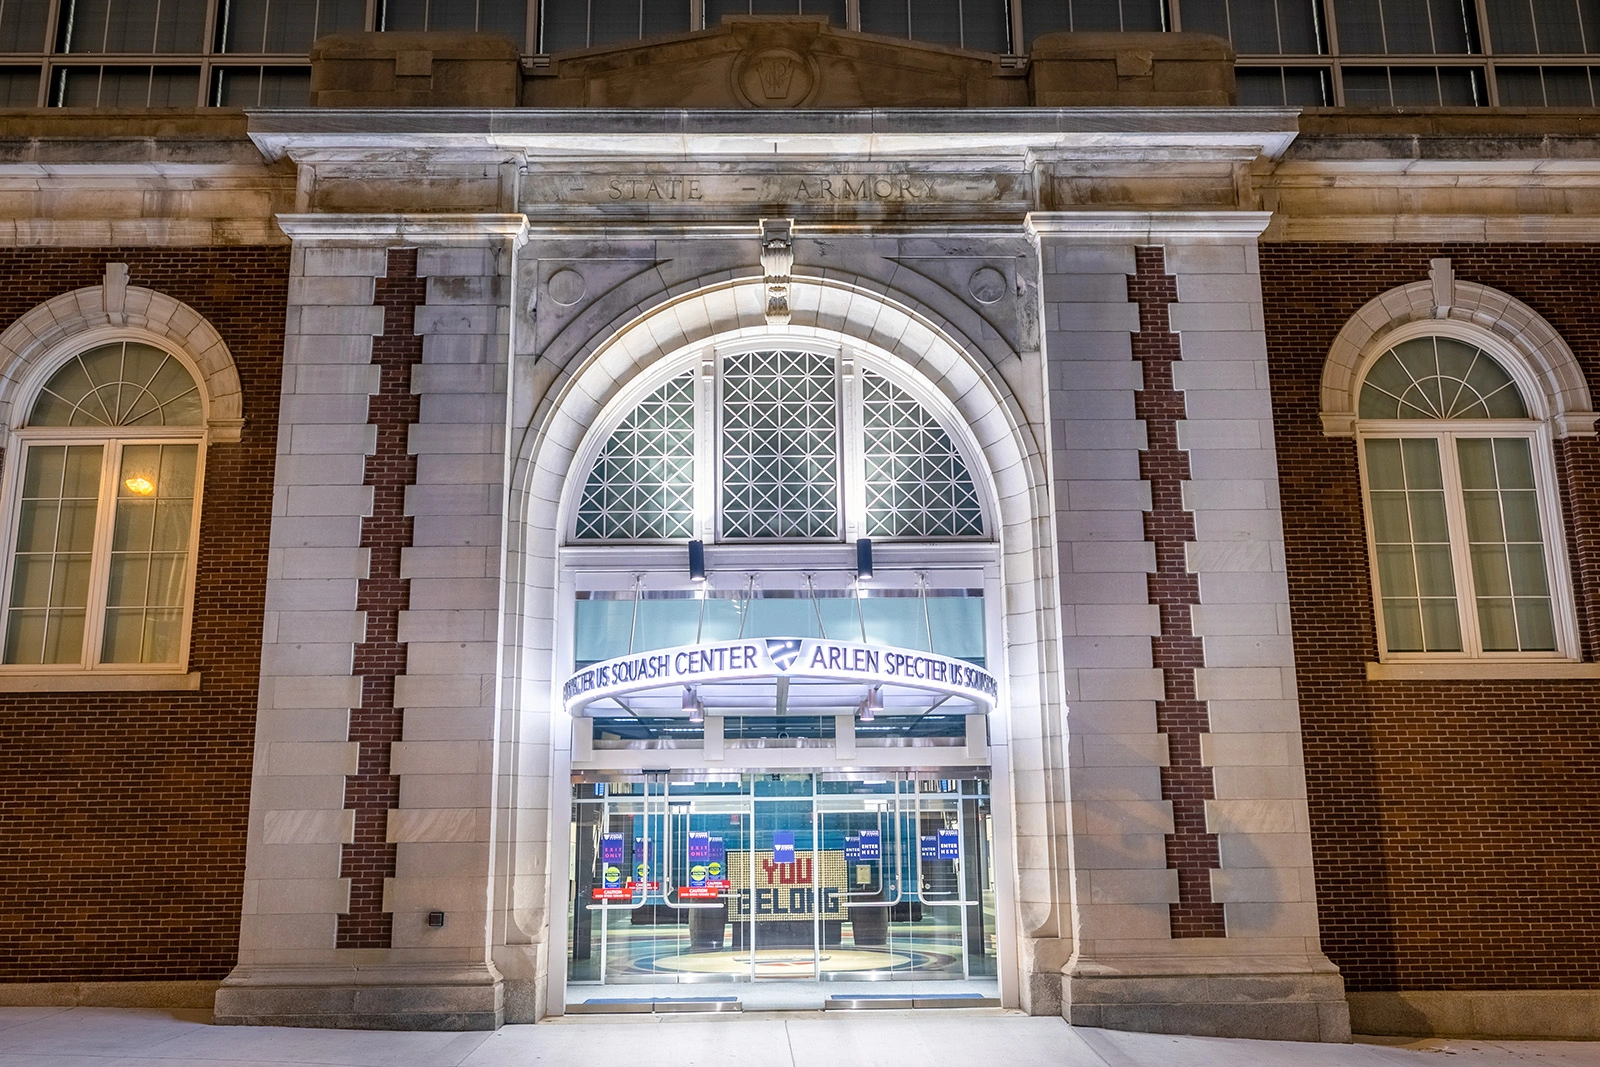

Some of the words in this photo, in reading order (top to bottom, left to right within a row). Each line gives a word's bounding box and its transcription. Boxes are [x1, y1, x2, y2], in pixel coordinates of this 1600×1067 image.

[608, 179, 703, 200] STATE
[793, 178, 938, 200] ARMORY
[596, 665, 610, 688] US
[611, 654, 671, 685] SQUASH
[675, 645, 758, 675] CENTER
[809, 645, 880, 674] ARLEN
[883, 651, 948, 683] SPECTER
[949, 663, 963, 686] US
[762, 857, 813, 884] YOU
